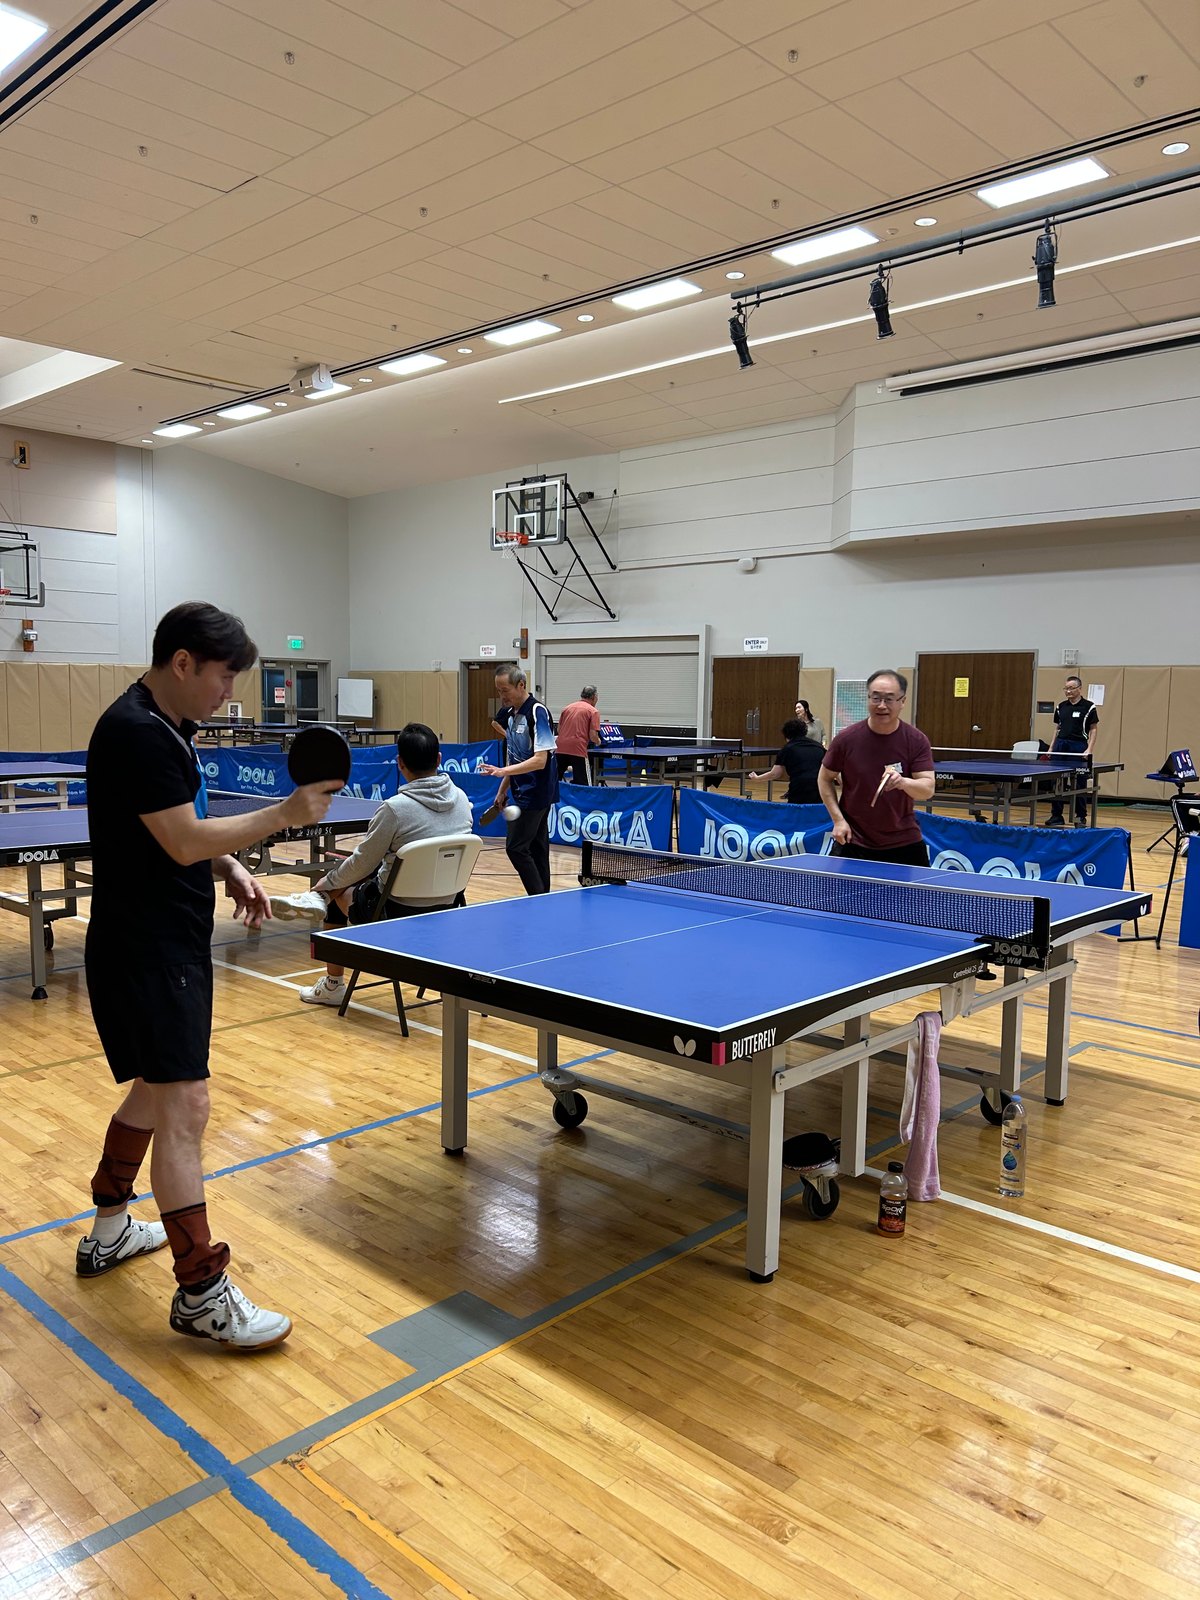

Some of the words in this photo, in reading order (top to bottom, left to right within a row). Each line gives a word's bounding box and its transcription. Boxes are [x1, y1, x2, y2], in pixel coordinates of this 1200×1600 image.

[18, 849, 60, 863] JOOLA
[993, 941, 1039, 959] JOOLA
[1006, 956, 1022, 965] WM
[731, 1027, 777, 1060] BUTTERFLY
